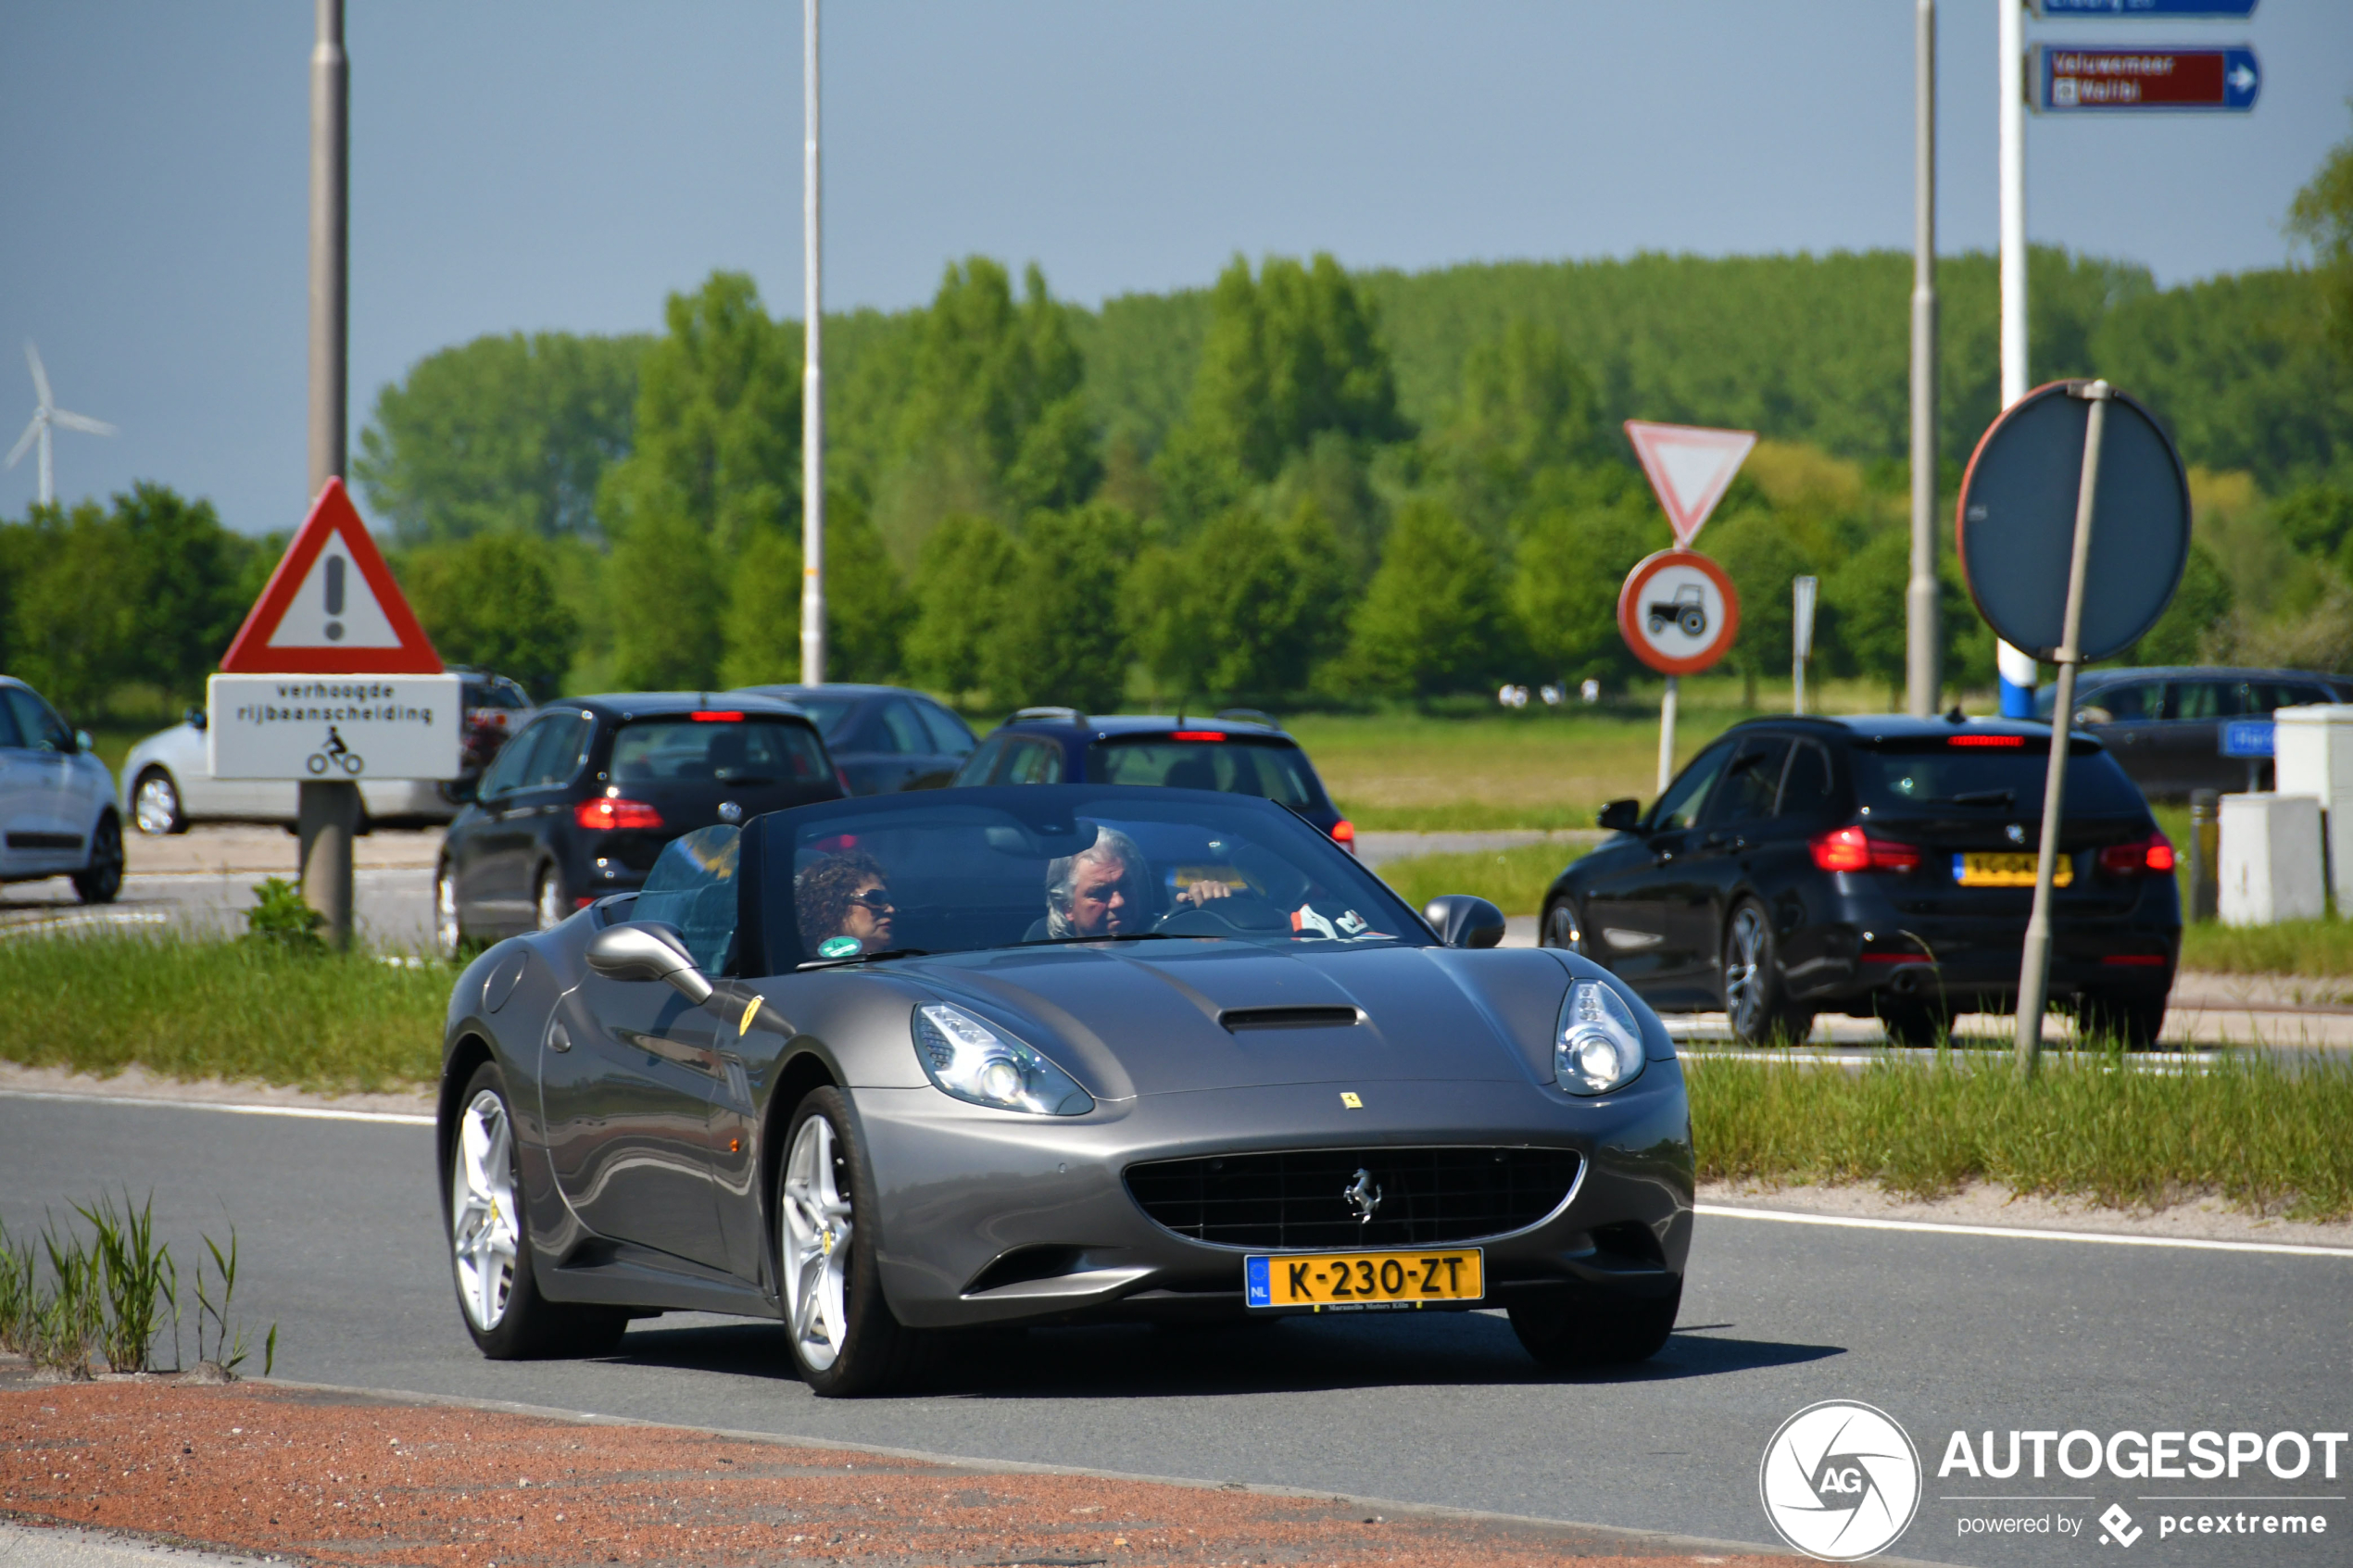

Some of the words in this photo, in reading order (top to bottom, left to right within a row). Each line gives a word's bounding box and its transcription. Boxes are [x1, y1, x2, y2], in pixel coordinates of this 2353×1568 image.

[2053, 53, 2173, 75] Veluwemeer
[277, 683, 394, 702] verhoogde
[238, 706, 433, 725] rijbaanscheiding
[1289, 1258, 1463, 1298] K-230-ZT
[1251, 1286, 1267, 1298] NL
